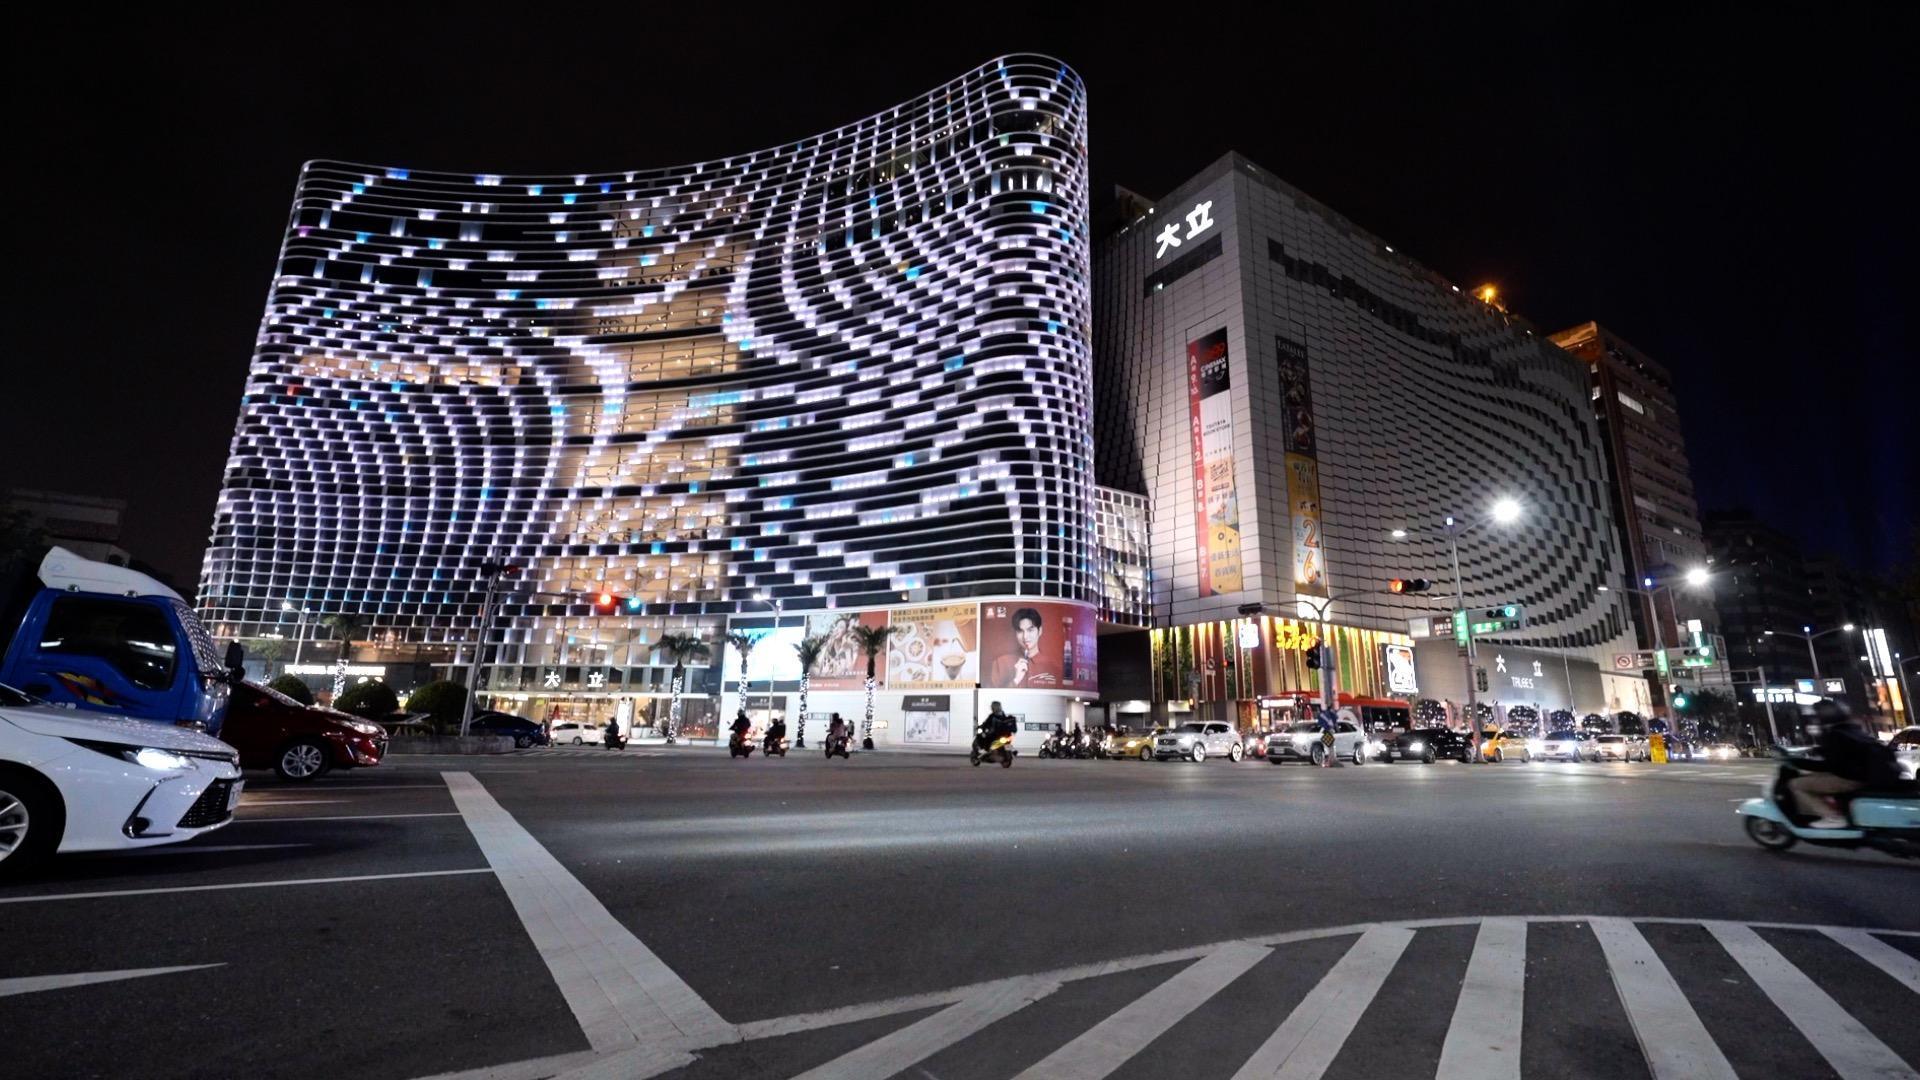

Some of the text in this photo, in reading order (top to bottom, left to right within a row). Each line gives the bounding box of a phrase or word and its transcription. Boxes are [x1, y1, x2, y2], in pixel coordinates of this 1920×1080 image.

[1156, 200, 1214, 259] 大立
[1495, 654, 1544, 677] 大立
[544, 671, 604, 688] 大立
